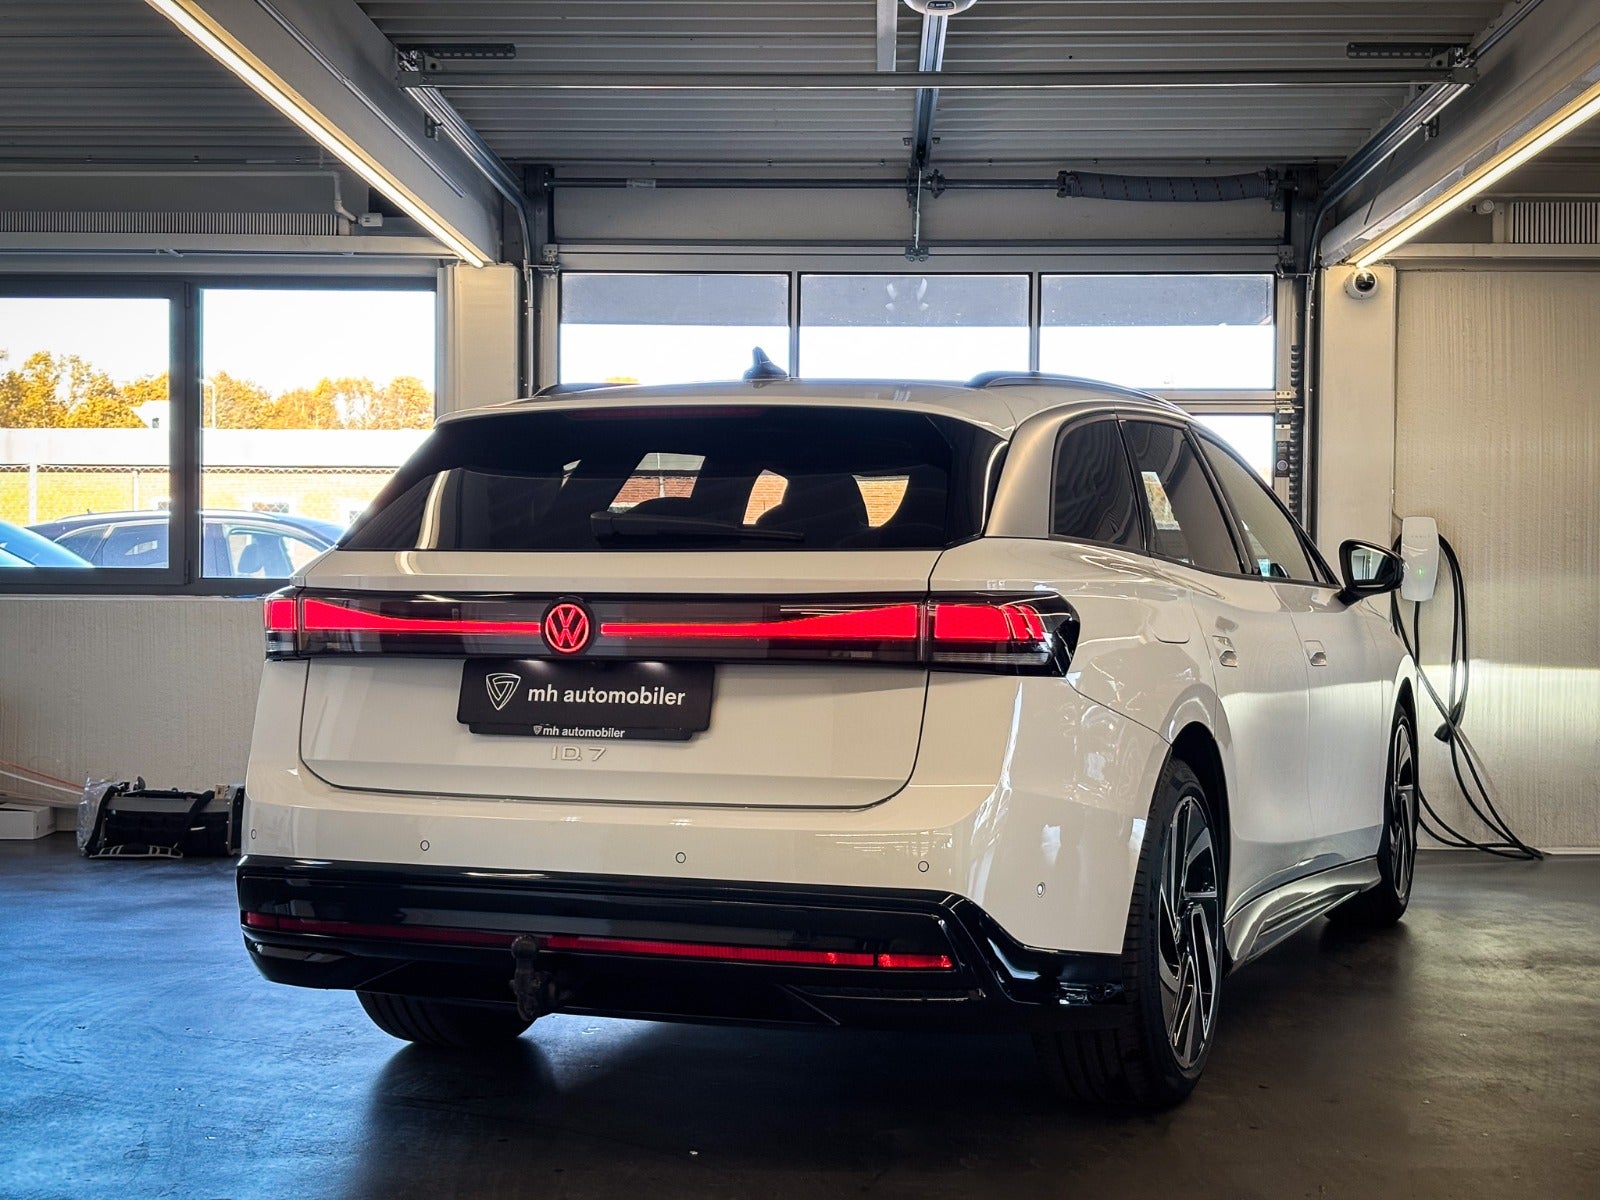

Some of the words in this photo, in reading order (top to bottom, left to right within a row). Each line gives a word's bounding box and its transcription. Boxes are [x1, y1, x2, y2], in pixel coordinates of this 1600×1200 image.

[546, 604, 589, 652] VW
[527, 684, 558, 702] mh
[563, 686, 685, 705] automobiler
[543, 726, 559, 736] mh
[561, 727, 626, 738] automobiler
[588, 746, 607, 761] 7
